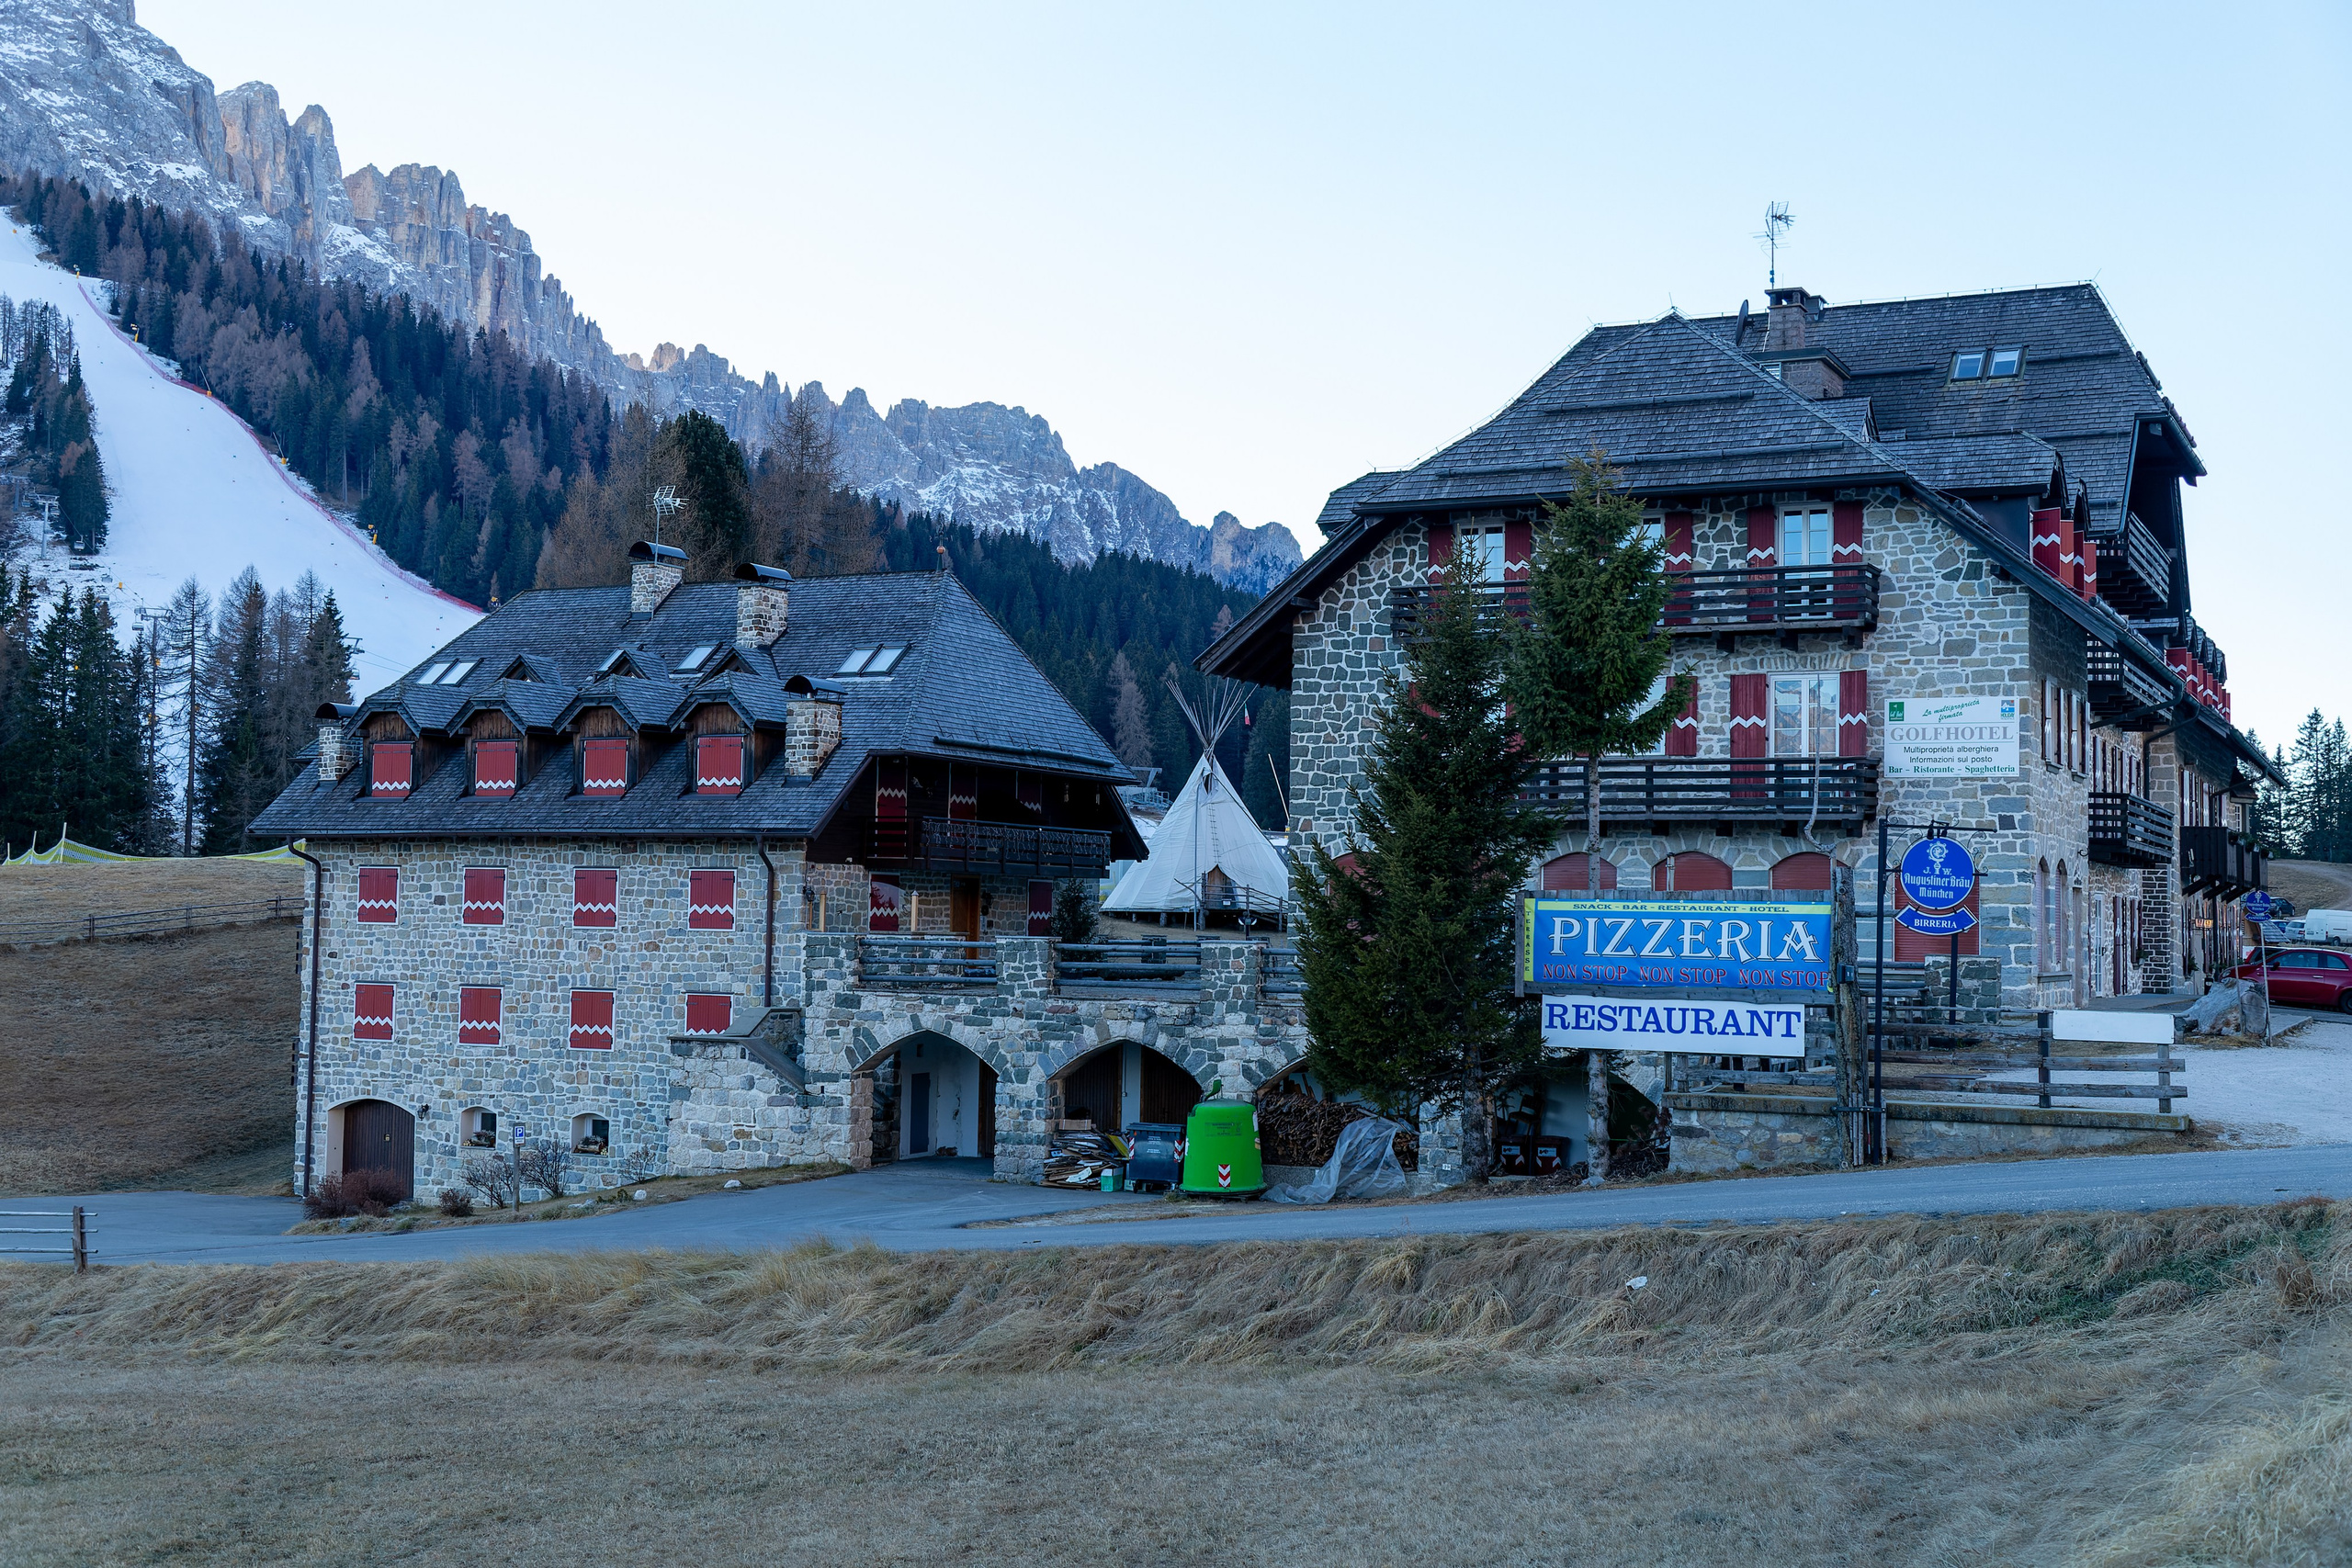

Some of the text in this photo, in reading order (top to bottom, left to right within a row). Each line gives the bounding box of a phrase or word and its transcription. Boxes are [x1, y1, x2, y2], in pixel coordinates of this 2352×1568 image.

[1939, 711, 1963, 723] firmata
[1891, 726, 2014, 741] GOLFHOTEL
[1904, 746, 1999, 754] Multiproprietà alberghiera
[1914, 765, 1955, 773] Ristorante
[1964, 765, 2015, 774] Spaghetteria
[1905, 873, 1970, 888] Augustiner Bräu
[1919, 887, 1953, 899] München
[1914, 919, 1957, 929] BIRRERIA
[1548, 917, 1826, 964] PIZZERIA
[1544, 964, 1829, 987] NON STOP NON STOP NON STOP
[1544, 1003, 1802, 1038] RESTAURANT
[517, 1128, 522, 1137] P
